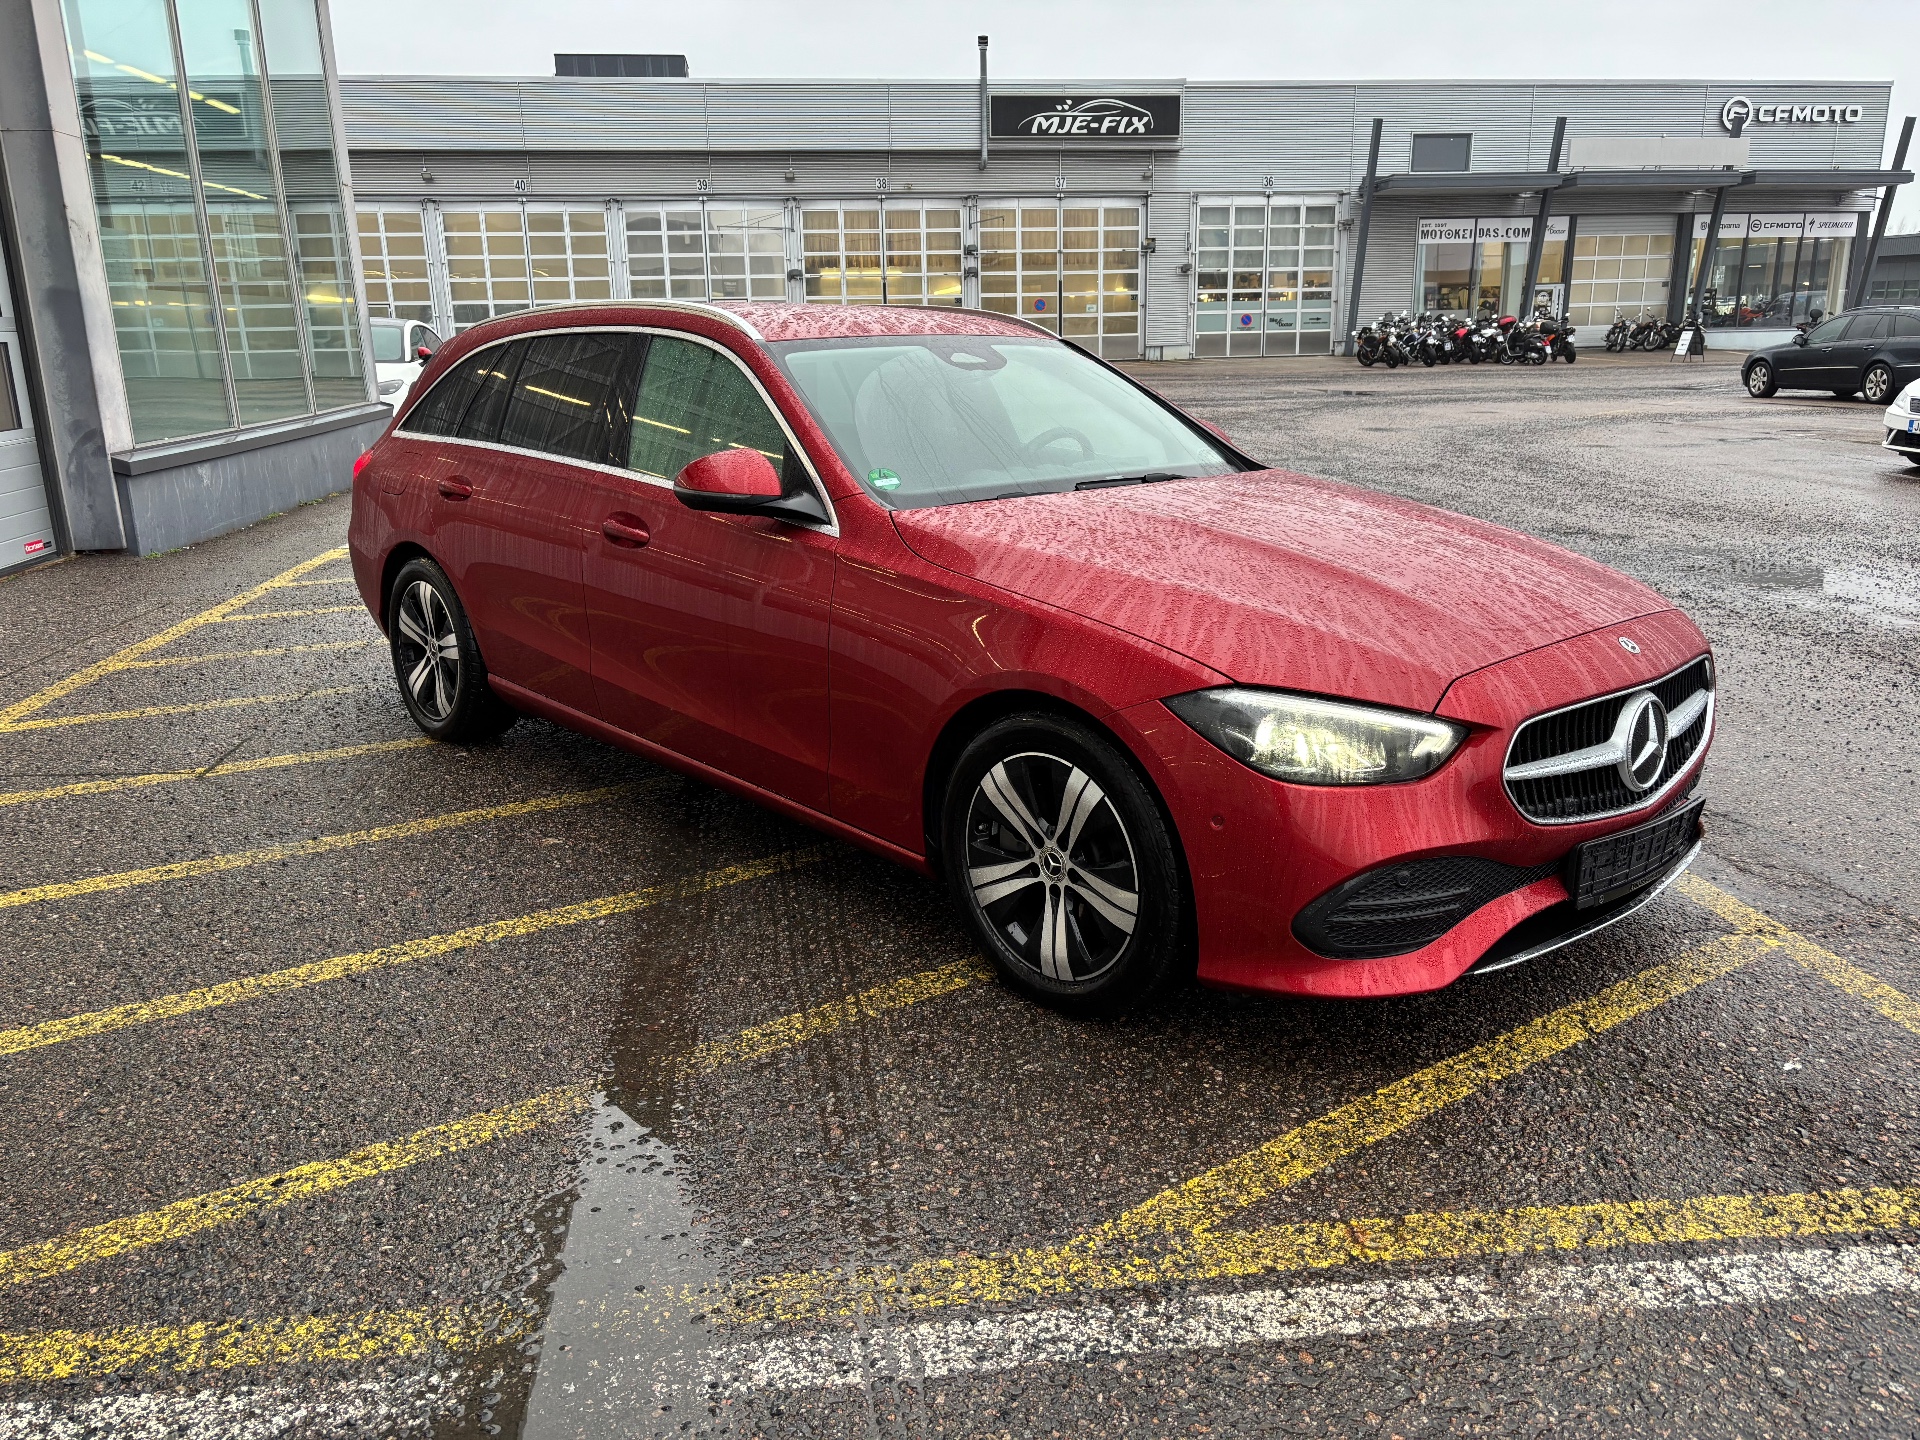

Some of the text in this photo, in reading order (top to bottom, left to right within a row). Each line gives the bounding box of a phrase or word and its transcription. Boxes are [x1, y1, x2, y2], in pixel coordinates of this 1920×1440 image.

[1758, 105, 1863, 122] CFMOTO
[1031, 116, 1149, 134] MJE-FIX
[515, 180, 526, 191] 40
[697, 180, 708, 191] 39
[877, 178, 887, 189] 38
[1056, 177, 1066, 188] 37
[1263, 176, 1274, 187] 36
[1817, 221, 1854, 229] SPECIALIZED
